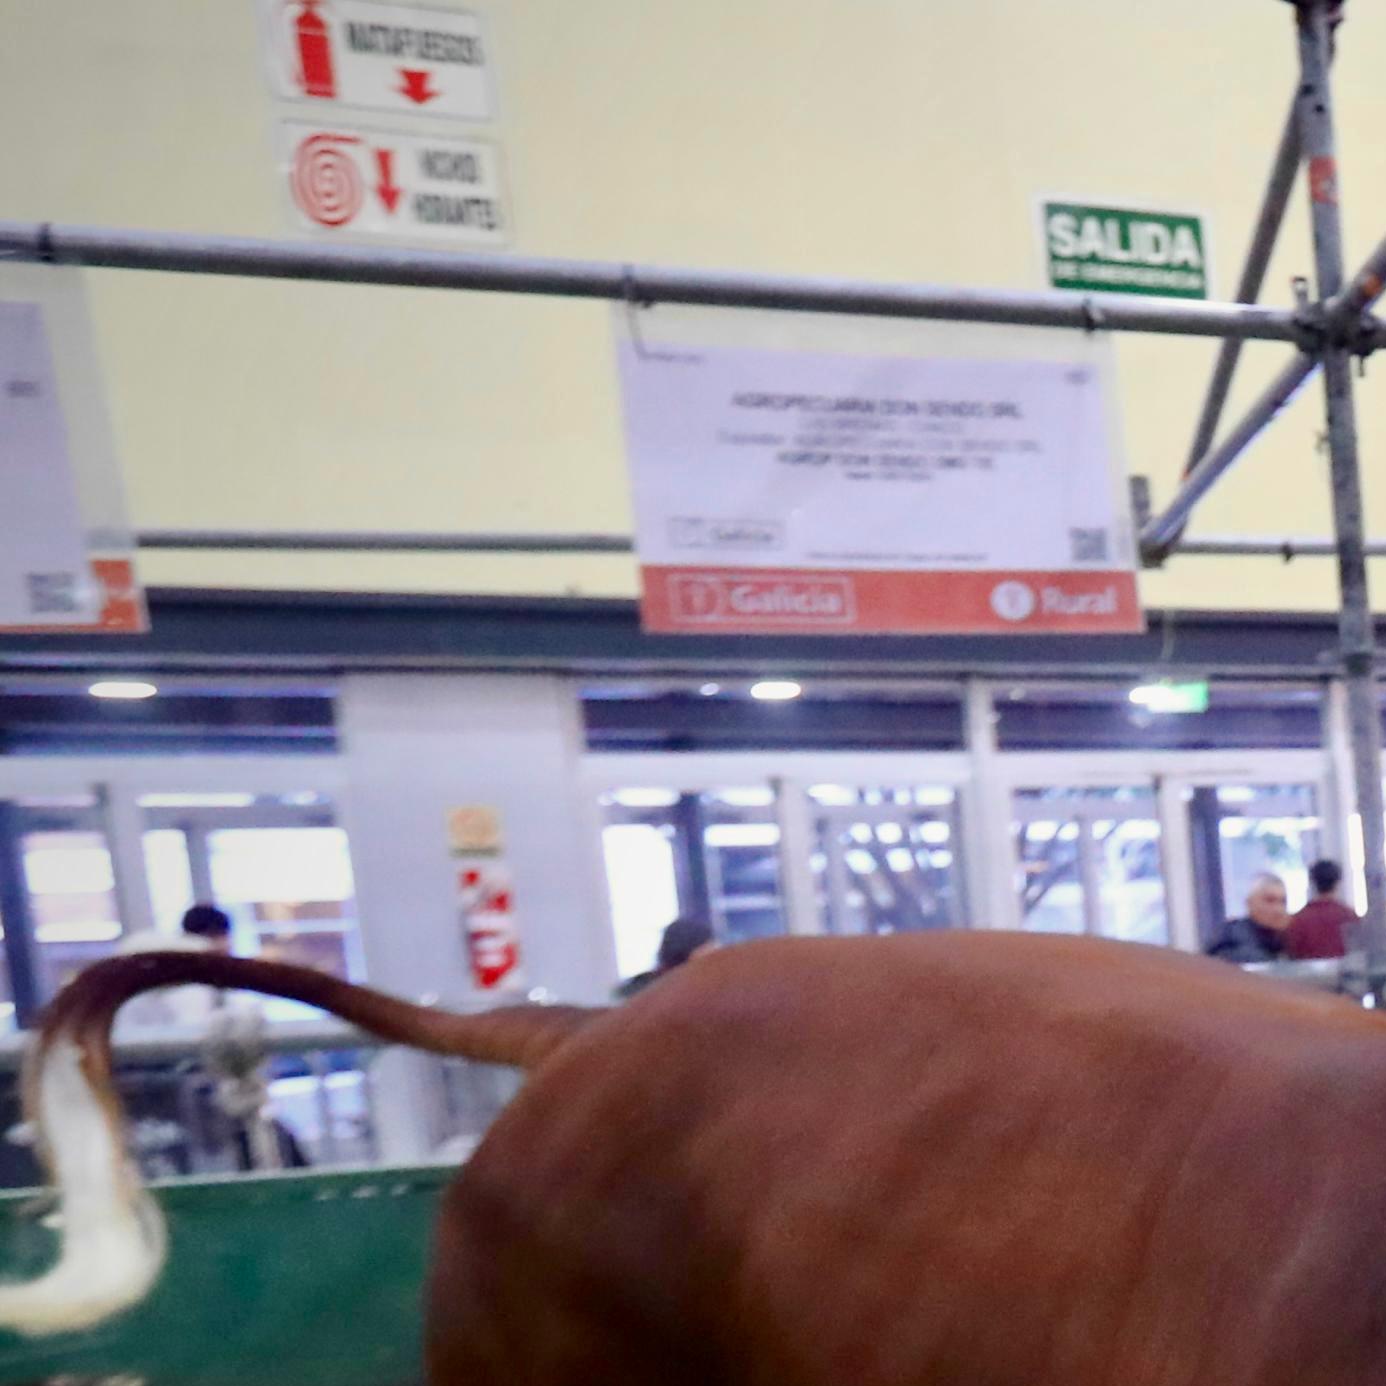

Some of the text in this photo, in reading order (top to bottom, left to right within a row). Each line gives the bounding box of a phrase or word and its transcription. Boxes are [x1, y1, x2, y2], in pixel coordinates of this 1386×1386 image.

[1049, 212, 1202, 268] SALIDA
[730, 583, 843, 614] Galicia
[1042, 585, 1117, 614] Rural
